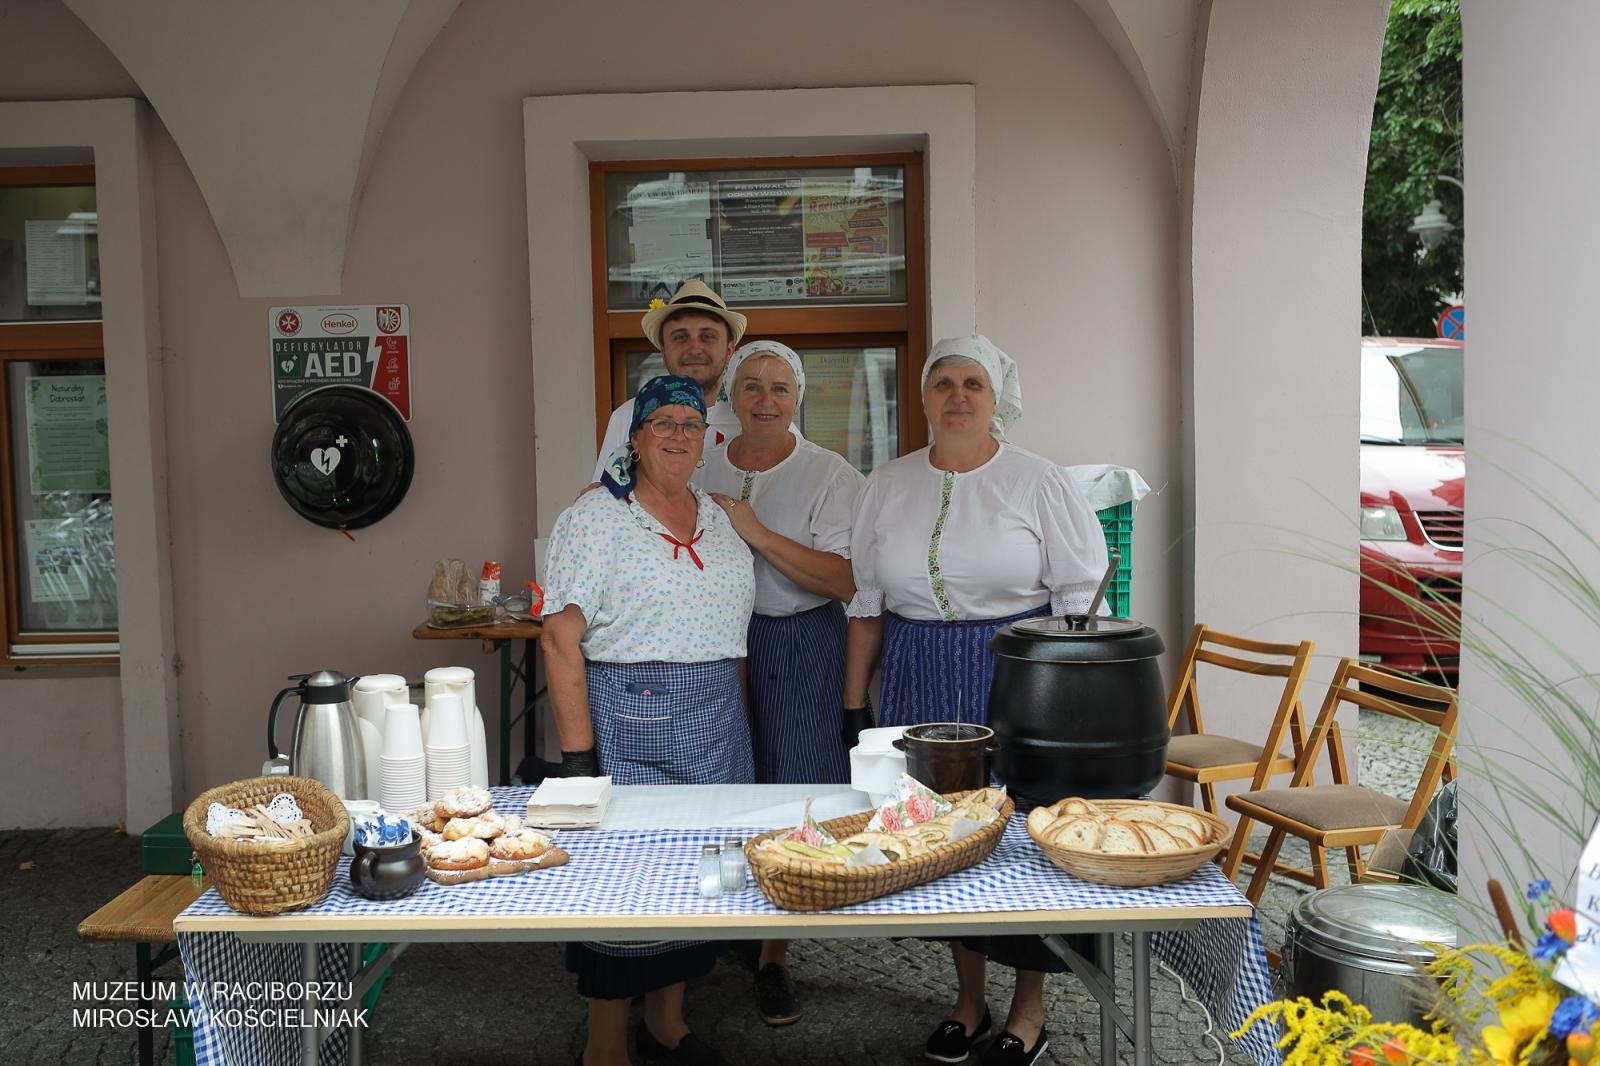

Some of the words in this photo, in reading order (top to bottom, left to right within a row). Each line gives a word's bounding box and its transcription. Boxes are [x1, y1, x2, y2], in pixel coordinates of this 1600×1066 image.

[323, 320, 355, 329] Henkel
[275, 341, 361, 352] DEFIBRYLATOR
[304, 352, 362, 378] AED
